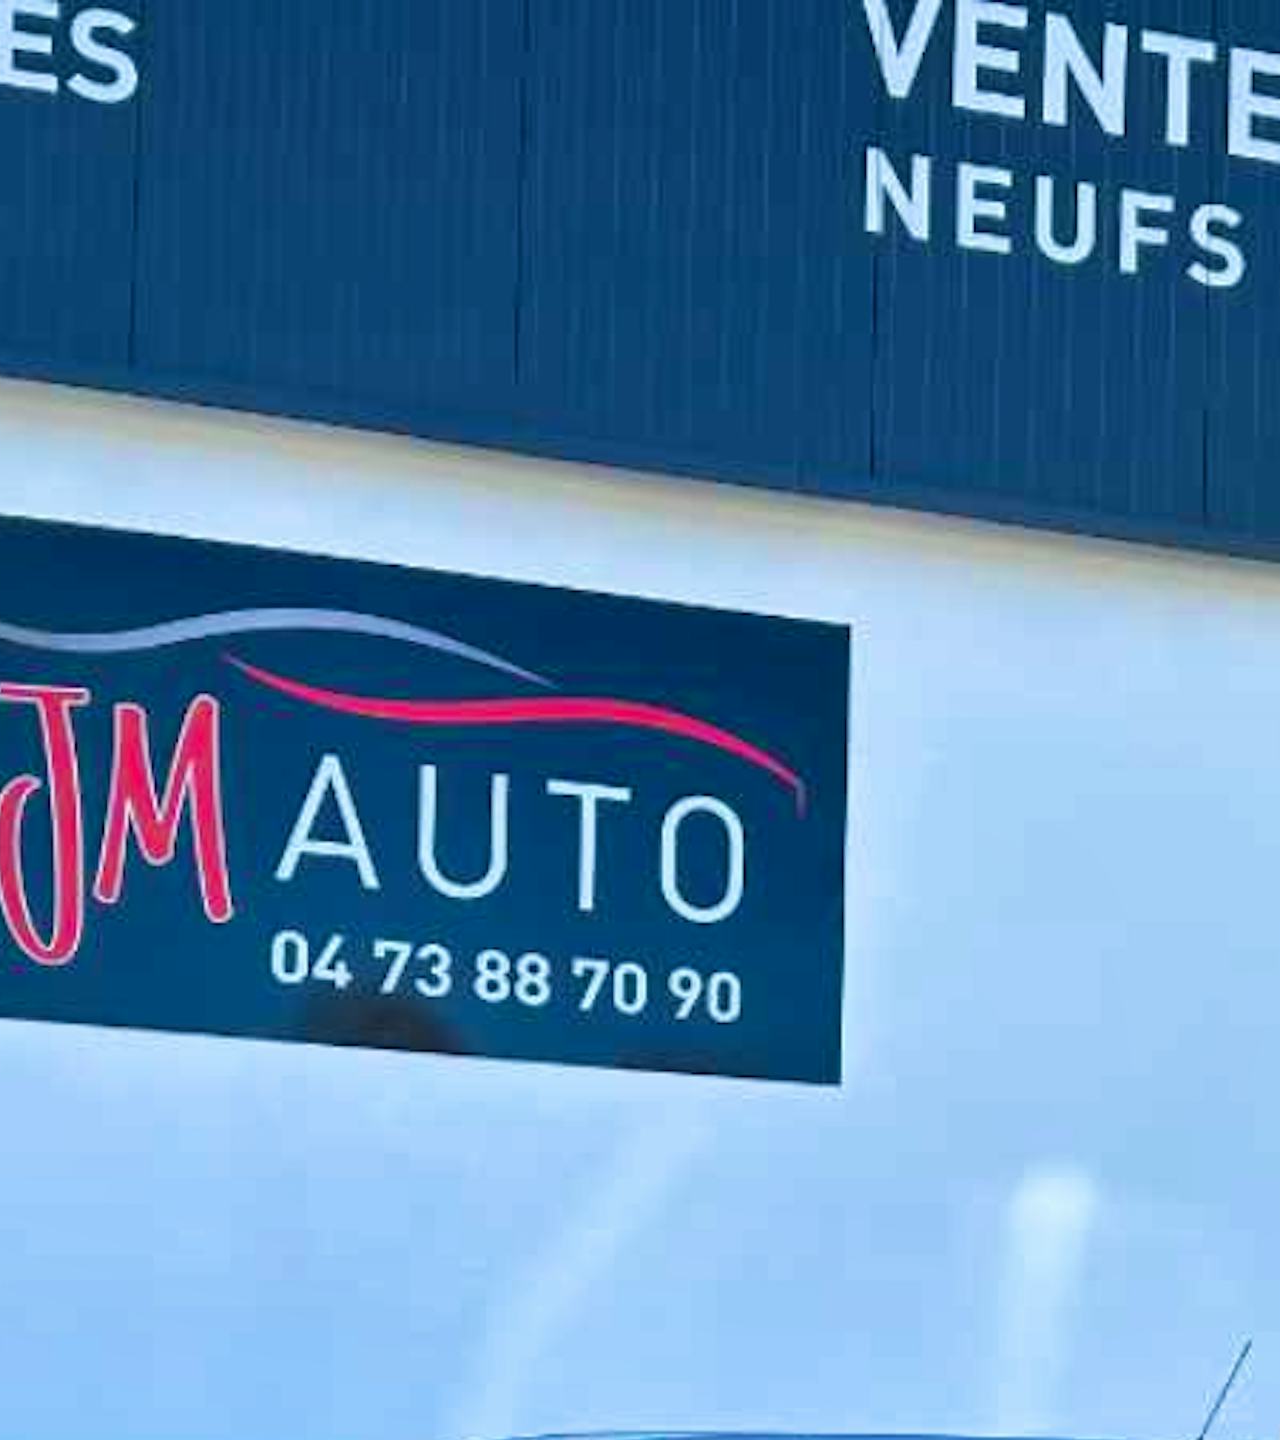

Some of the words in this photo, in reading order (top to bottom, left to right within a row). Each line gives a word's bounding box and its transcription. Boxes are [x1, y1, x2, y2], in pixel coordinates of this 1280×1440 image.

[864, 146, 1245, 288] NEUFS
[275, 753, 745, 924] AUTO
[270, 930, 353, 988] 04
[372, 940, 453, 999] 73
[474, 949, 551, 1007] 88
[571, 958, 649, 1014] 70
[668, 968, 742, 1023] 90
